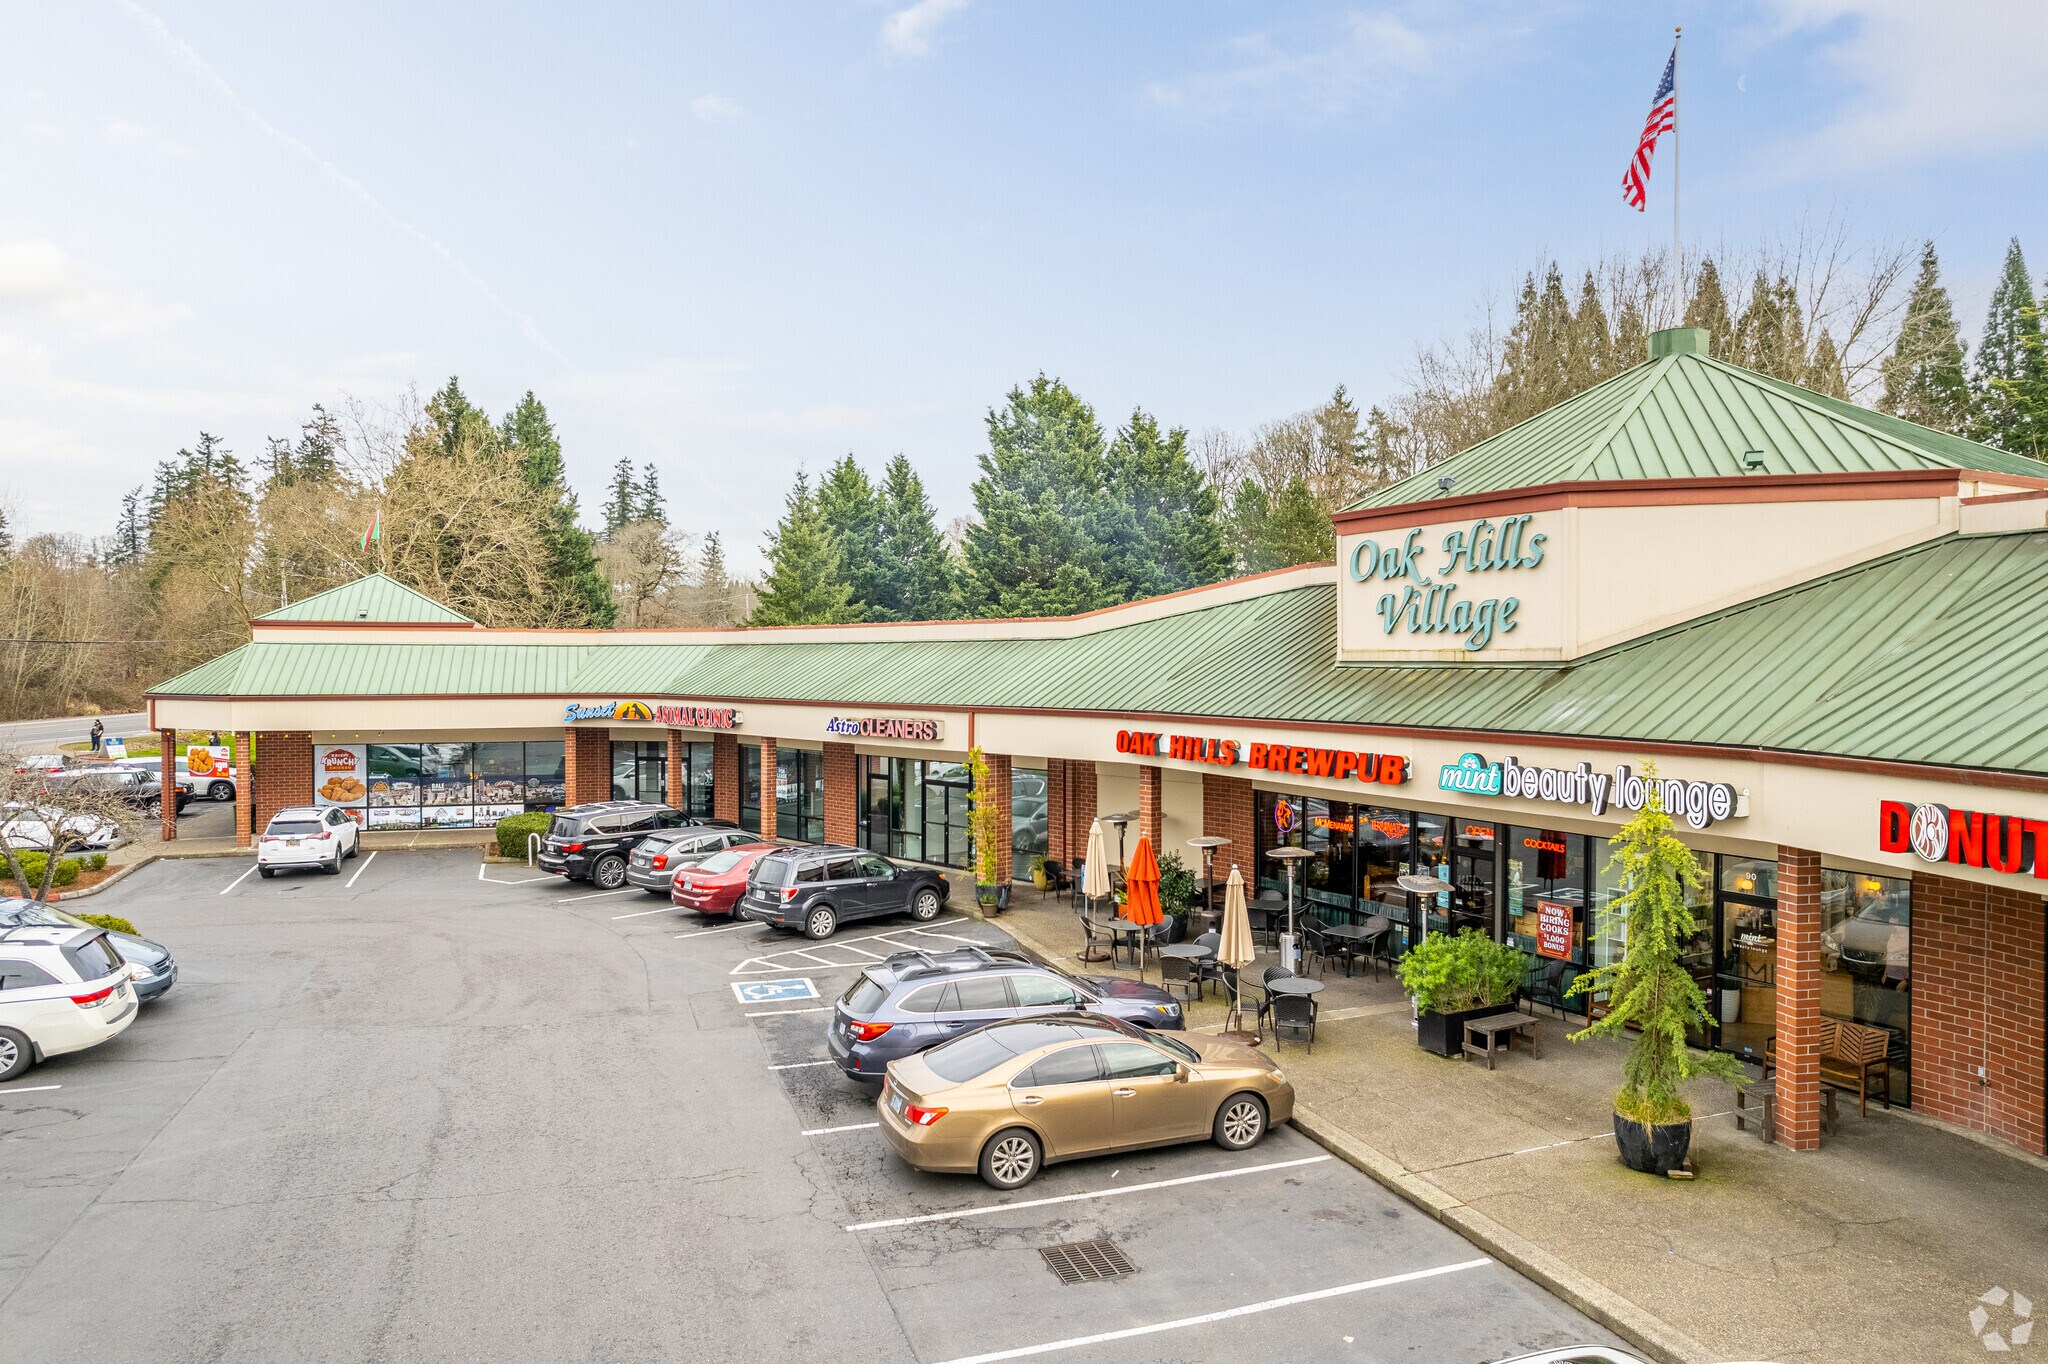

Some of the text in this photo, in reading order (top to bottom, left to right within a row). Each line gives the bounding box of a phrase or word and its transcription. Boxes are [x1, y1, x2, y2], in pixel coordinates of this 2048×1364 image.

[1350, 514, 1547, 586] Oak Hills
[1376, 583, 1519, 651] Village
[563, 701, 617, 723] Sunset
[655, 705, 734, 729] ANIMAL CLINIC
[825, 716, 936, 741] Astro CLEANERS
[320, 754, 361, 767] KRUNCHY
[1116, 730, 1407, 785] OAK HILLS BREWPUB
[1440, 756, 1732, 829] mint beauty lounge
[1370, 819, 1409, 834] TERMINATOR
[1465, 825, 1494, 838] OPEN
[1523, 838, 1566, 854] COCKTAILS
[1745, 872, 1757, 881] 90
[1545, 906, 1565, 917] NOW
[1540, 913, 1570, 928] HIRING
[1540, 923, 1569, 936] COOKS
[1740, 932, 1761, 943] mint
[1543, 941, 1565, 952] BONUS
